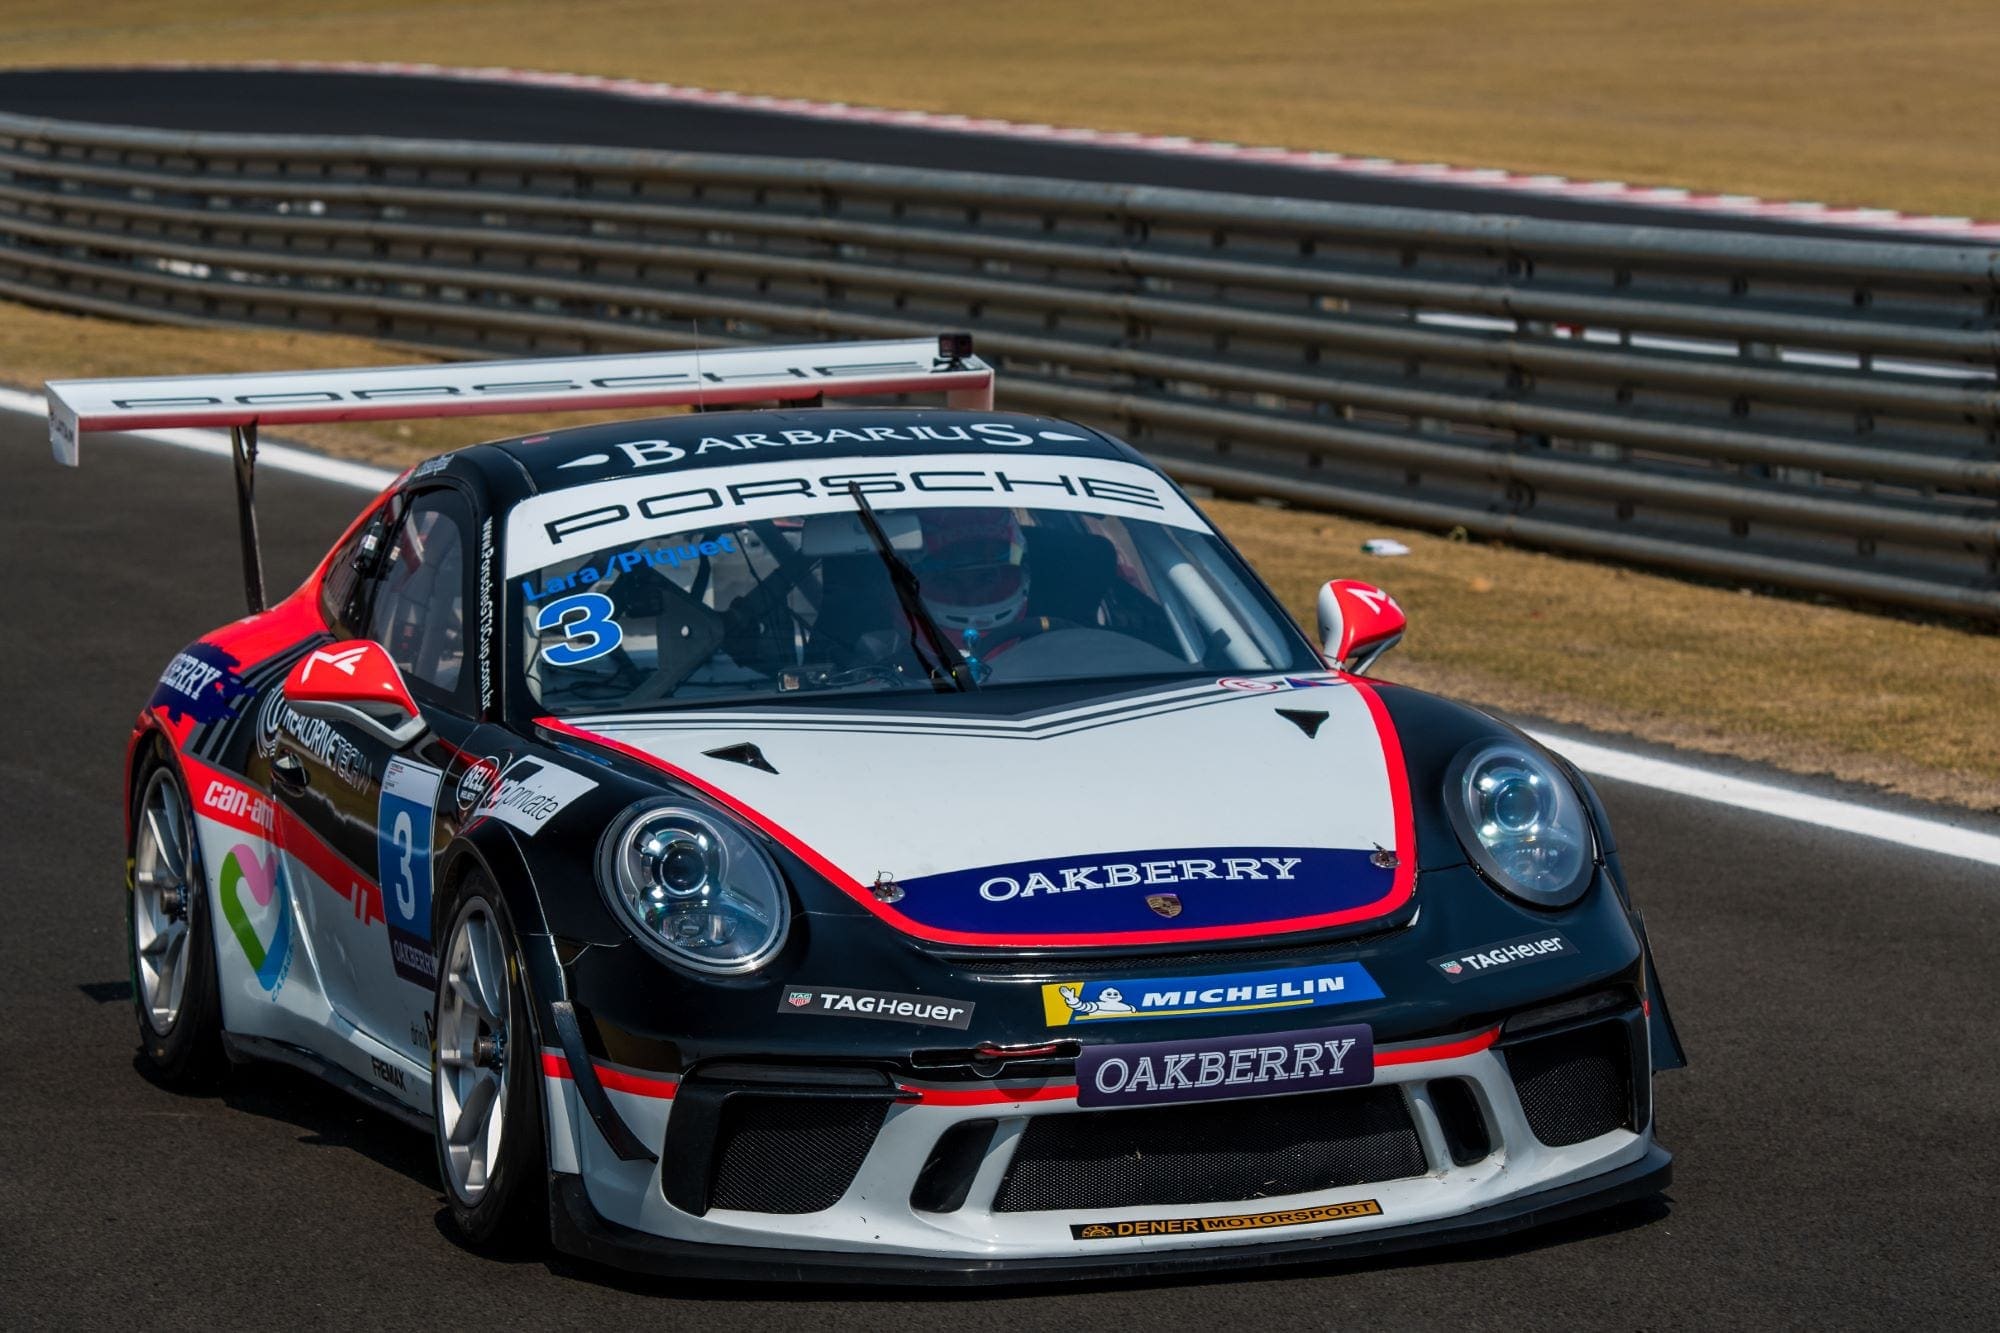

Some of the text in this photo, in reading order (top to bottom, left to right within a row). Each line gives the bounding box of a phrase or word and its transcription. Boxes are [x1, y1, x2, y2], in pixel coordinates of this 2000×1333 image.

[111, 360, 928, 409] PORSCHE
[613, 422, 1035, 469] BARBARIUS
[543, 470, 1165, 546] PORSCHE
[536, 592, 623, 666] 3
[203, 780, 274, 832] can-am
[393, 810, 416, 921] 3
[978, 857, 1302, 902] OAKBERRY
[1141, 976, 1345, 1007] MICHELIN
[1094, 1038, 1356, 1094] OAKBERRY
[1117, 1201, 1373, 1237] DENER MOTORSPORT
